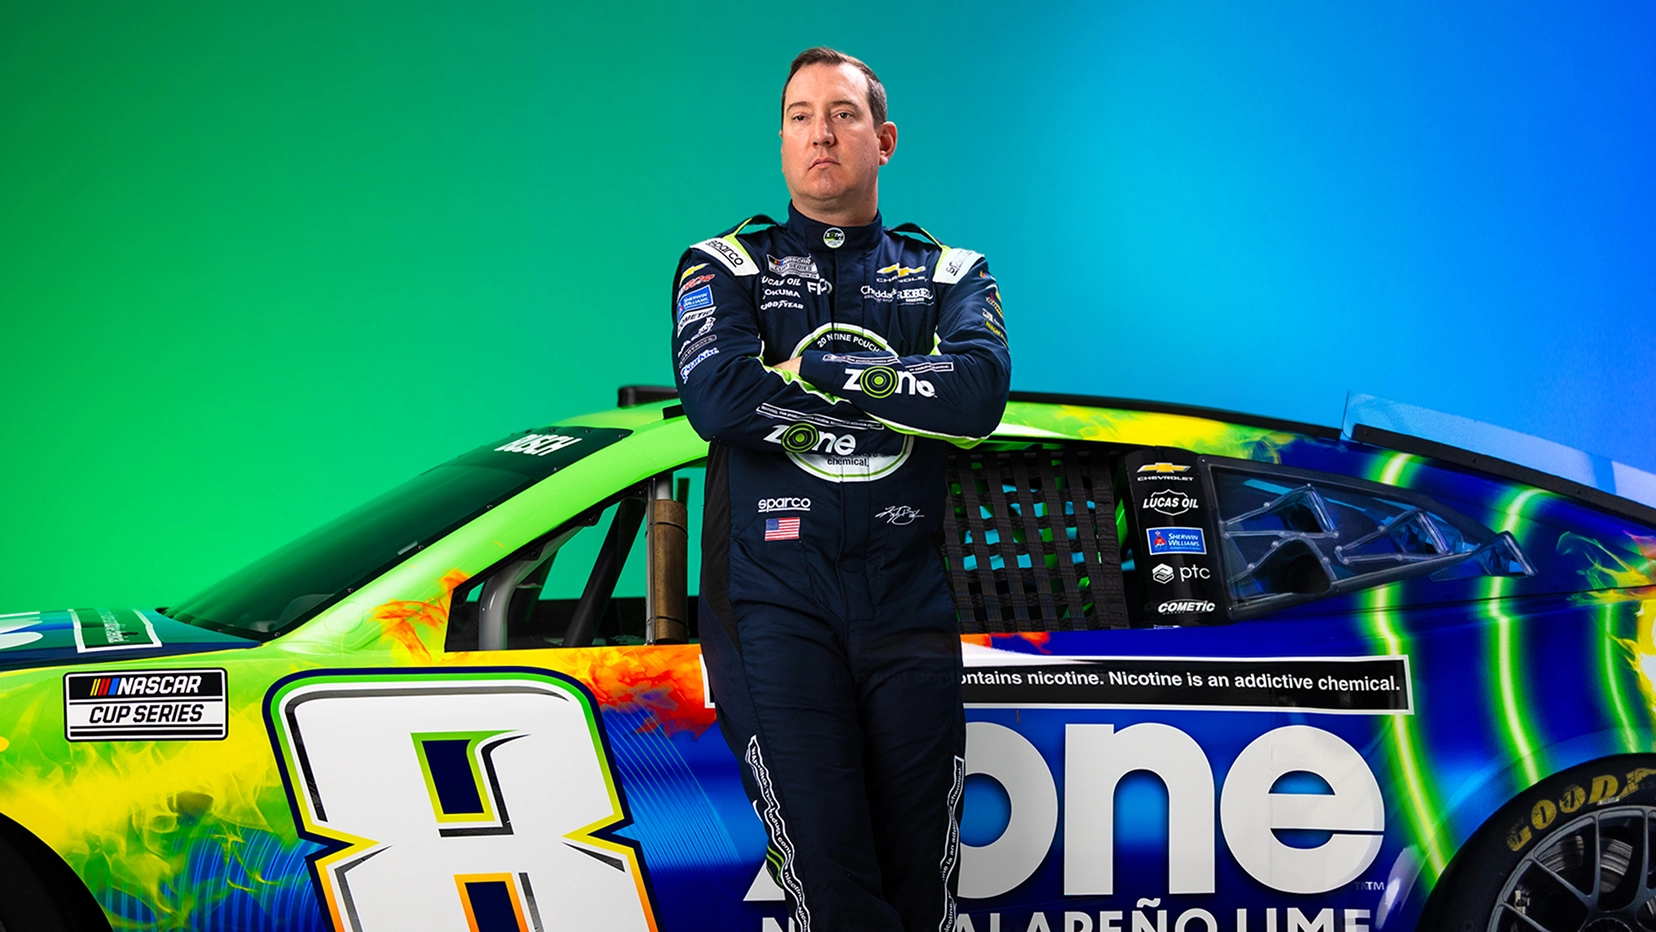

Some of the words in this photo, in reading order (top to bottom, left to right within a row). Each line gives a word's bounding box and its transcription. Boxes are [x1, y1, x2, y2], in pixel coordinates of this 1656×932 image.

[761, 275, 785, 286] UCAS
[786, 278, 802, 286] OIL
[764, 288, 801, 298] OKUMA
[678, 309, 713, 331] METIC
[817, 337, 827, 348] 20
[853, 336, 880, 352] POUCH
[763, 423, 857, 455] zone
[827, 457, 870, 467] chemical.
[758, 497, 811, 512] sparco
[1142, 497, 1180, 509] LUCAS
[1181, 498, 1199, 509] OIL
[1168, 533, 1199, 541] SHERWIN
[1168, 539, 1200, 547] WILLIAMS
[1179, 564, 1211, 582] ptc
[1158, 599, 1216, 613] COMETIC
[117, 675, 202, 695] NASCAR
[961, 671, 1023, 685] ntains
[1028, 671, 1104, 685] nicotine.
[1108, 671, 1182, 686] Nicotine
[1187, 672, 1203, 687] is
[1207, 674, 1230, 687] an
[1234, 673, 1313, 690] addictive
[1318, 675, 1401, 691] chemical.
[89, 705, 132, 724] CUP
[132, 703, 205, 723] SERIES
[262, 666, 662, 932] 8
[743, 722, 1385, 901] one
[1365, 881, 1385, 891] TM
[956, 897, 1218, 932] AAPEÑO
